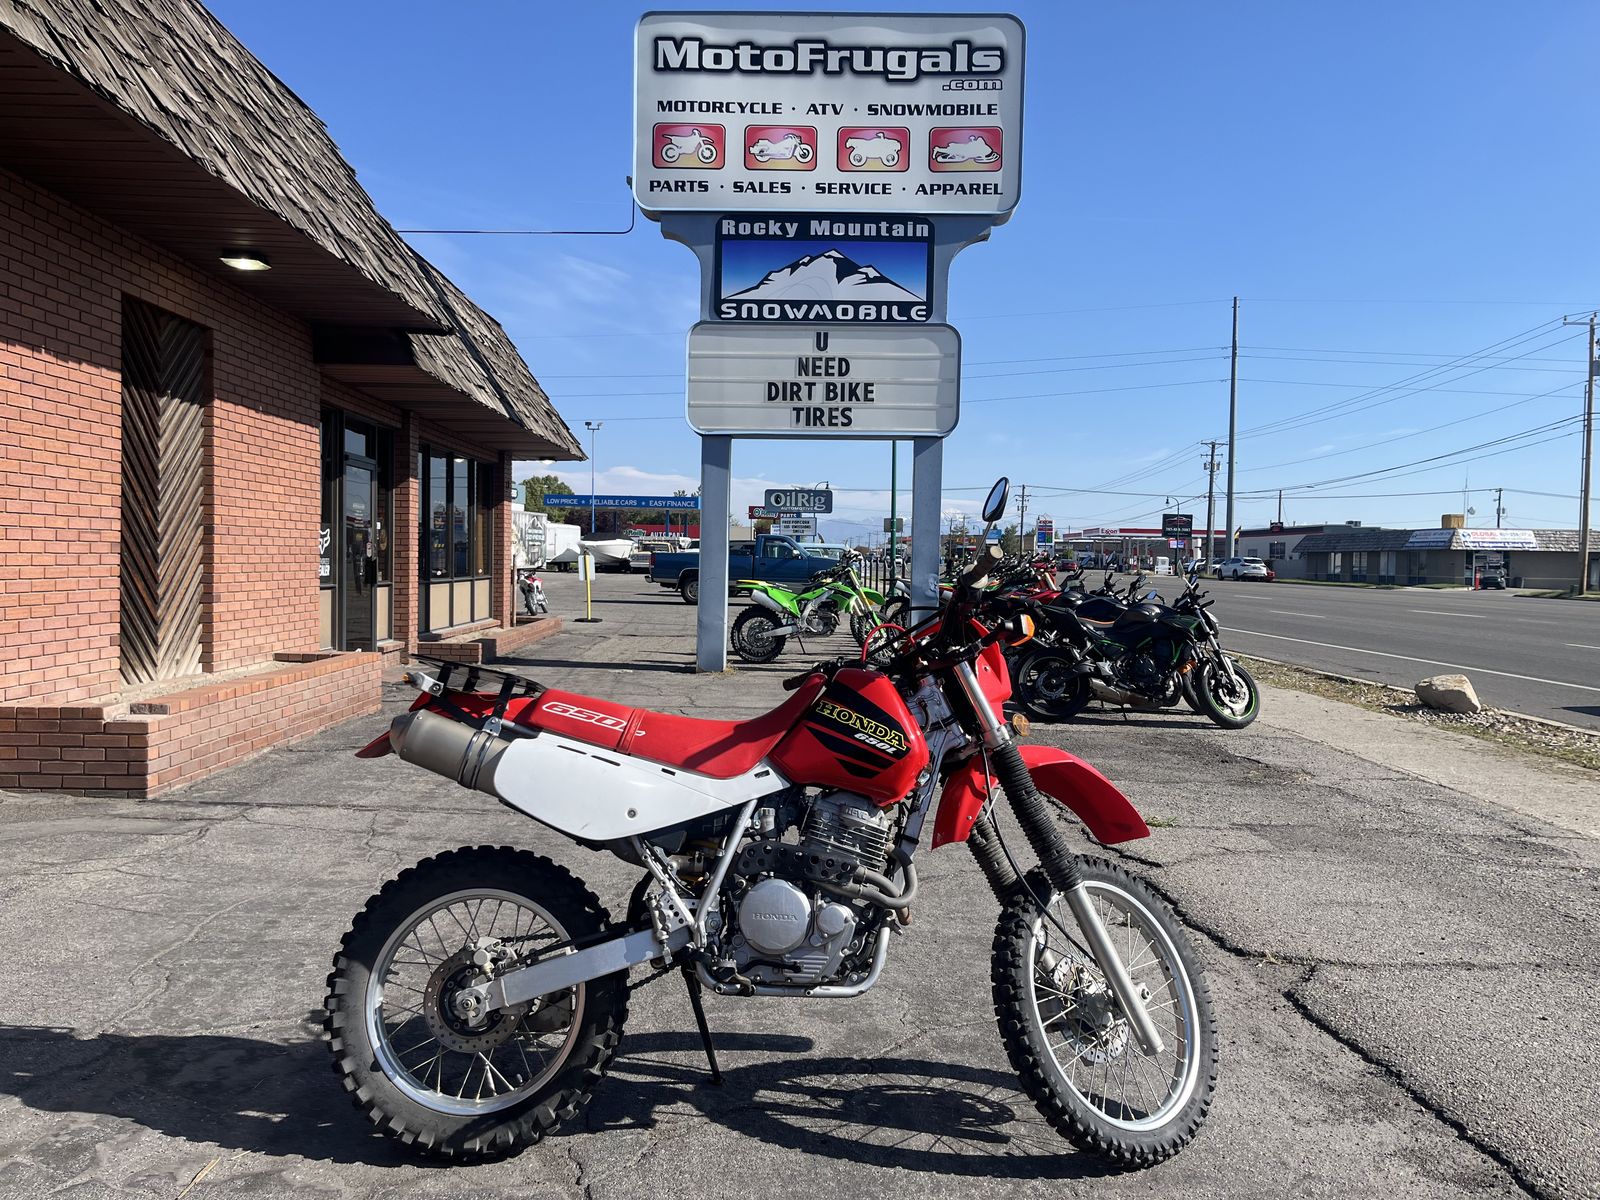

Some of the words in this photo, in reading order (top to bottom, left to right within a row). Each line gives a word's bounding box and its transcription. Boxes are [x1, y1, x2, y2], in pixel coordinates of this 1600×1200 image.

[654, 38, 1004, 81] MotoFrugals
[942, 78, 1003, 91] .com
[657, 100, 783, 115] MOTORCYCLE
[806, 103, 844, 116] ATV
[867, 103, 999, 117] SNOWMOBILE
[649, 180, 709, 193] PARTS
[733, 181, 792, 194] SALES
[815, 182, 892, 195] SERVICE
[915, 183, 1003, 196] APPAREL
[722, 219, 799, 238] Rocky
[810, 220, 929, 237] Mountain
[721, 303, 926, 321] SNOWMOBILE
[815, 332, 829, 352] U
[797, 357, 851, 377] NEED
[767, 382, 816, 402] DIRT
[825, 383, 875, 402] BIKE
[792, 407, 853, 427] TIRES
[771, 492, 826, 511] OilRig
[816, 700, 907, 751] HONDA
[853, 732, 898, 754] 650L
[752, 912, 799, 922] HONDA
